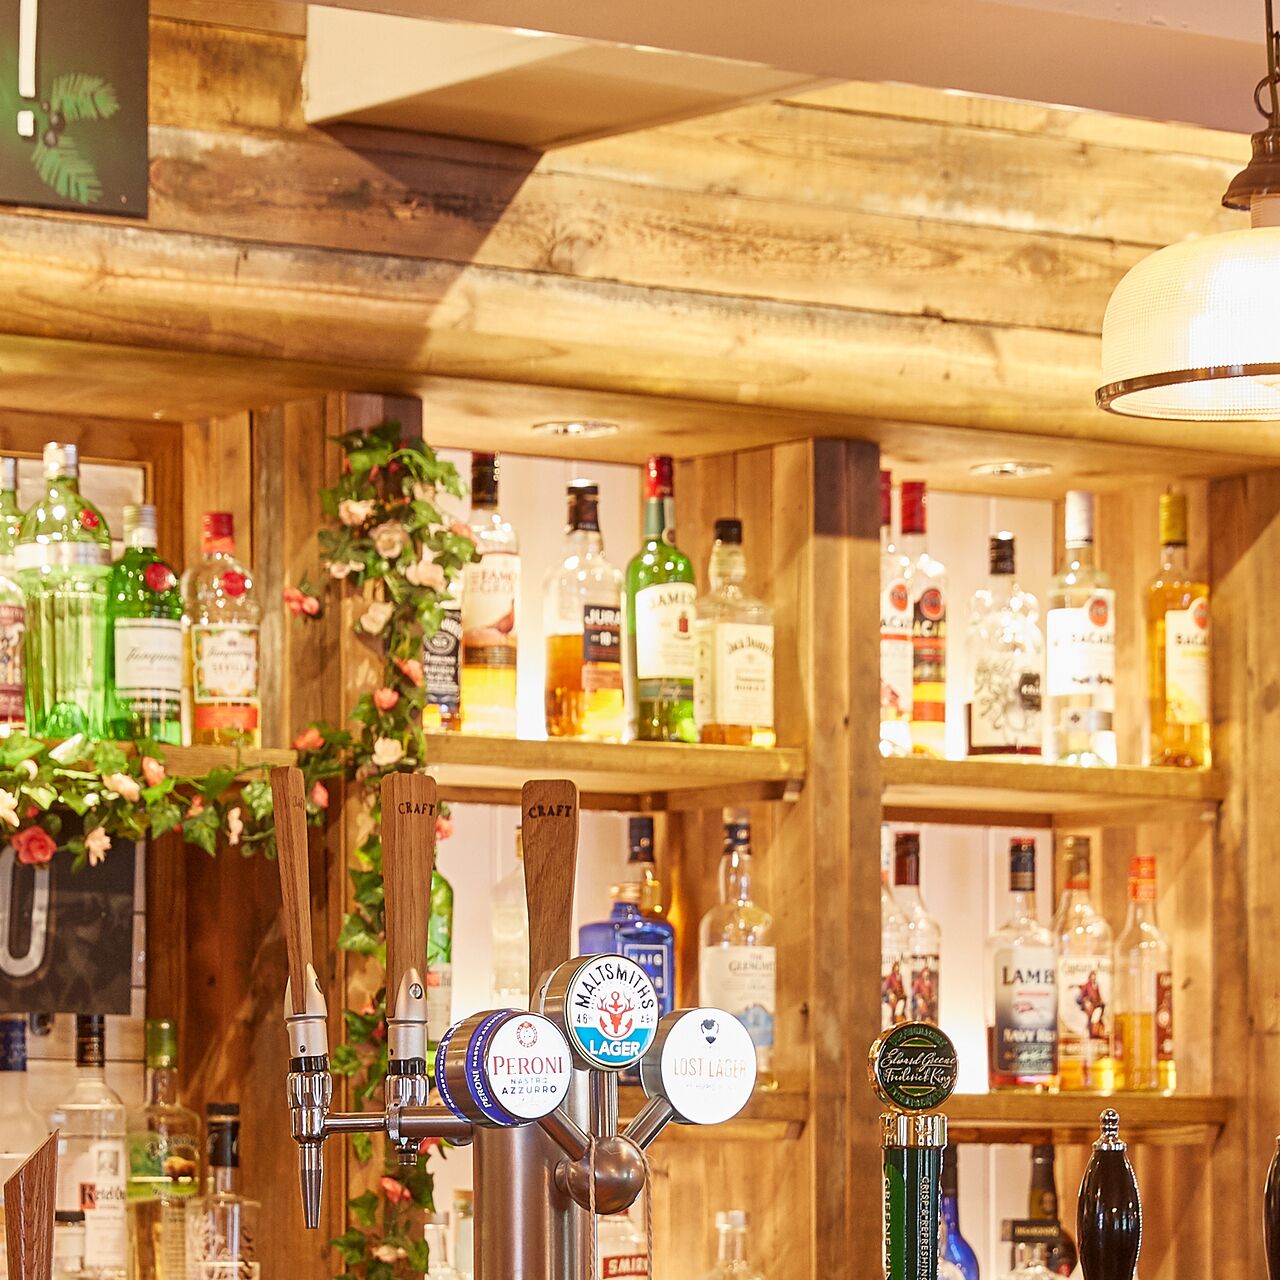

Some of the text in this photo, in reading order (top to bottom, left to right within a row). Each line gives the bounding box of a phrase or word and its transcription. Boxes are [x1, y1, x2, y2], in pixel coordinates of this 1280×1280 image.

[398, 803, 436, 816] CRAFT
[528, 805, 572, 818] CRAFT
[575, 963, 654, 1010] MALTSMITHS
[589, 1039, 641, 1057] LAGER
[492, 1055, 563, 1076] PERONI
[674, 1058, 748, 1079] LOST LAGER
[922, 1053, 956, 1073] Greene
[931, 1068, 956, 1088] King
[471, 1070, 492, 1108] PERONI
[501, 1085, 557, 1095] AZZURRO
